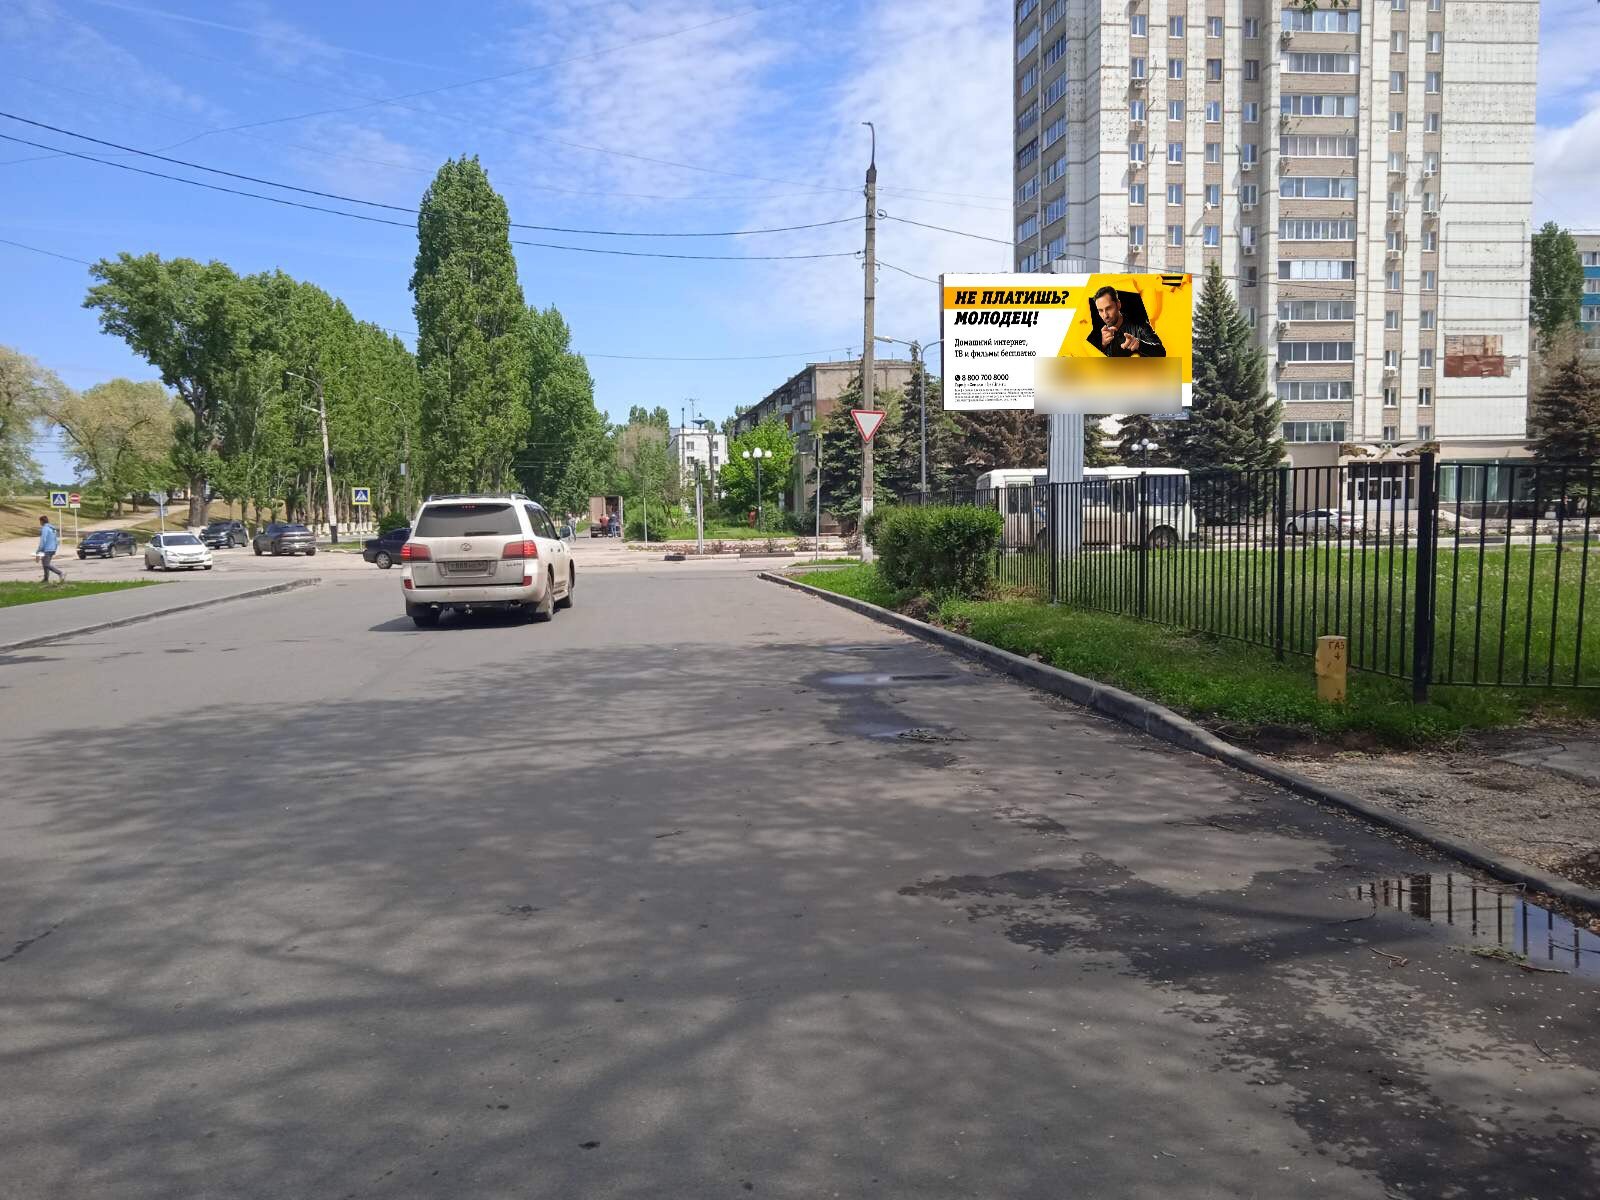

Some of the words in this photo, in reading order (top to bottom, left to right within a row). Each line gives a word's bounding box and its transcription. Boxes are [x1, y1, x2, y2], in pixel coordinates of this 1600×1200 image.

[955, 291, 977, 304] НЕ
[981, 291, 1069, 304] ПЛАТИШЬ?
[954, 311, 1039, 327] МОЛОДЕЦ!
[955, 338, 992, 347] Домашний
[994, 339, 1028, 347] интернет,
[971, 349, 999, 358] фильмы
[1000, 349, 1036, 357] бесплатно
